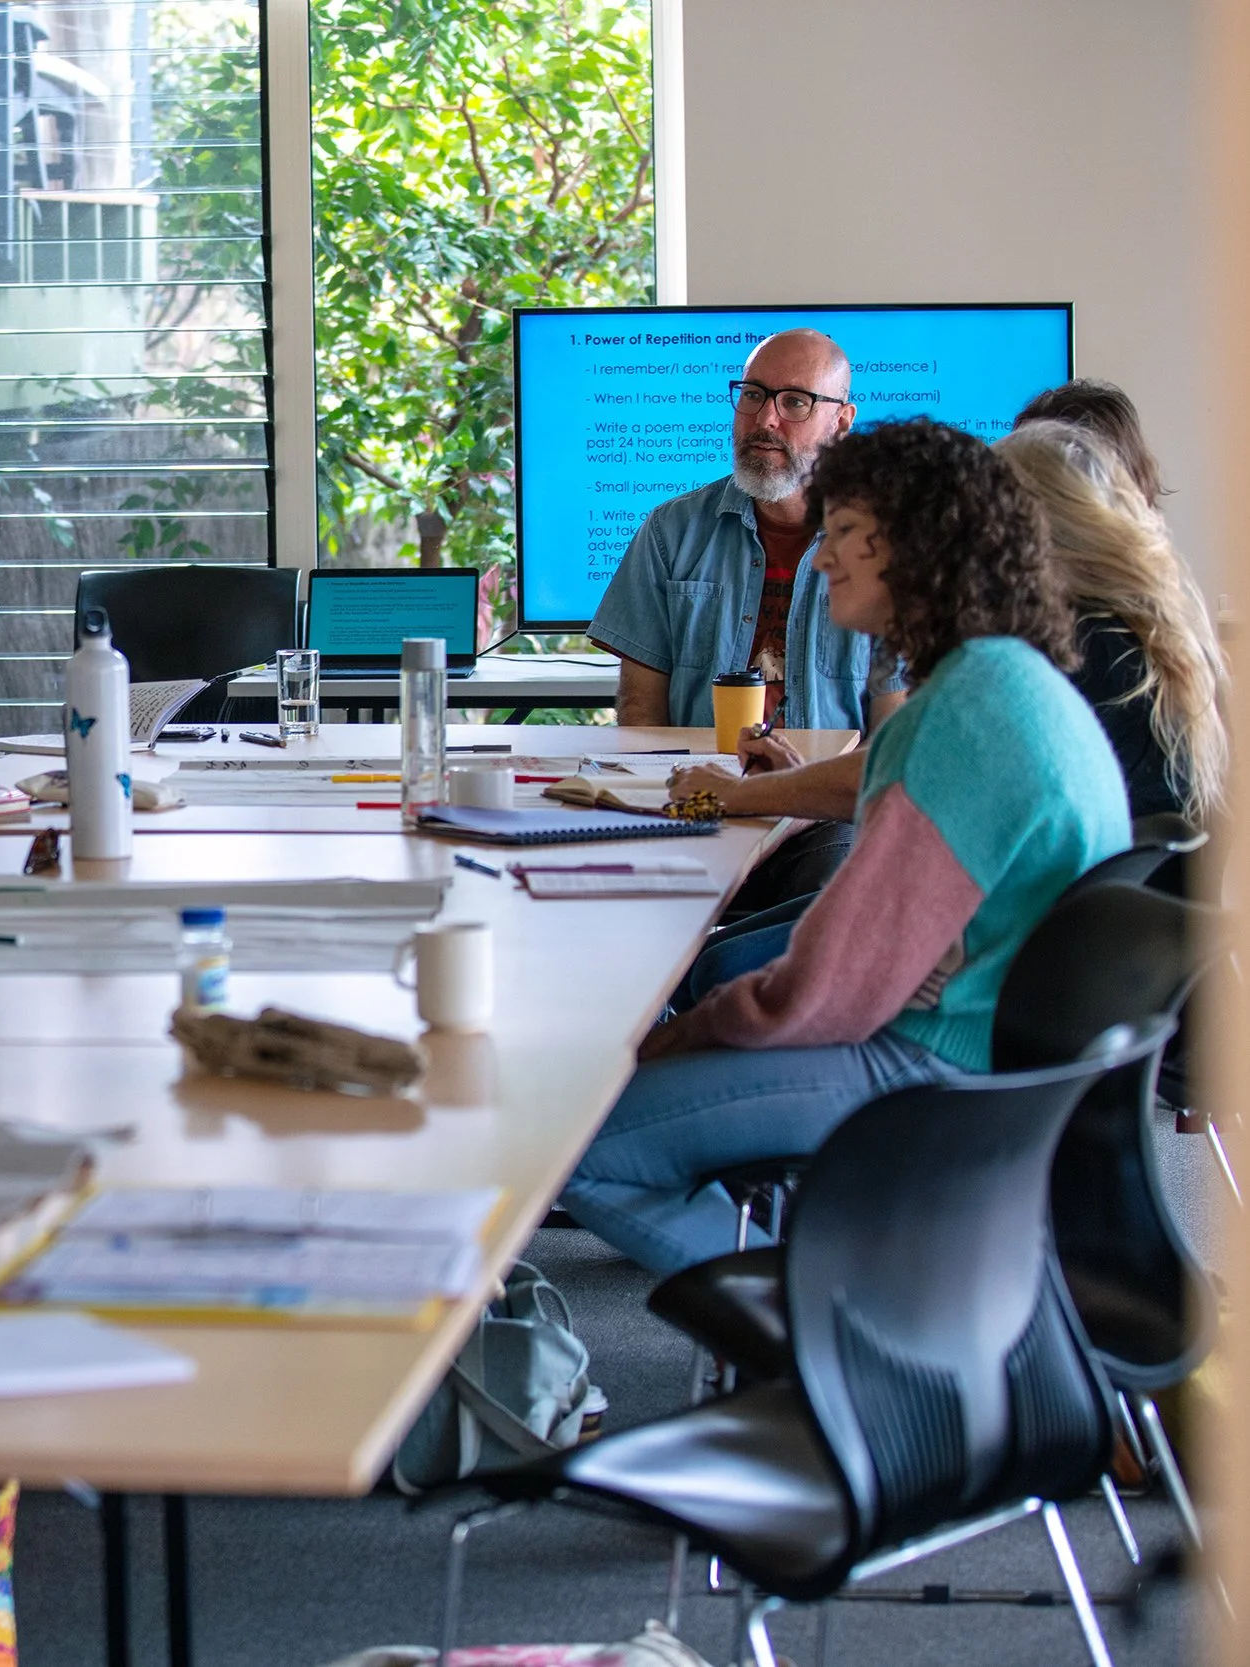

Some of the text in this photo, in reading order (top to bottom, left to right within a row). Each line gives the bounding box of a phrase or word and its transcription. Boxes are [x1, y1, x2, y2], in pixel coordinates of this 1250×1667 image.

[569, 333, 582, 346] 1.
[585, 333, 626, 346] Power
[629, 333, 643, 346] of
[646, 332, 712, 347] Repetition
[715, 331, 742, 345] and
[745, 331, 767, 344] the
[600, 361, 679, 376] remember/I
[683, 361, 719, 375] don't
[594, 391, 633, 404] When
[643, 392, 678, 404] have
[681, 391, 703, 404] the
[870, 389, 941, 405] Murakami)
[594, 421, 628, 434] Write
[631, 423, 641, 434] a
[644, 423, 685, 437] poem
[688, 420, 734, 435] explori
[975, 418, 987, 430] in
[991, 418, 1013, 431] the
[586, 436, 616, 450] past
[619, 435, 635, 448] 24
[638, 435, 673, 448] hours
[676, 435, 724, 451] (caring
[586, 450, 729, 465] world). No example is
[595, 480, 630, 493] Small
[632, 480, 688, 496] journeys
[589, 509, 599, 522] 1.
[602, 509, 636, 522] Write
[587, 527, 612, 539] you
[588, 554, 599, 566] 2.
